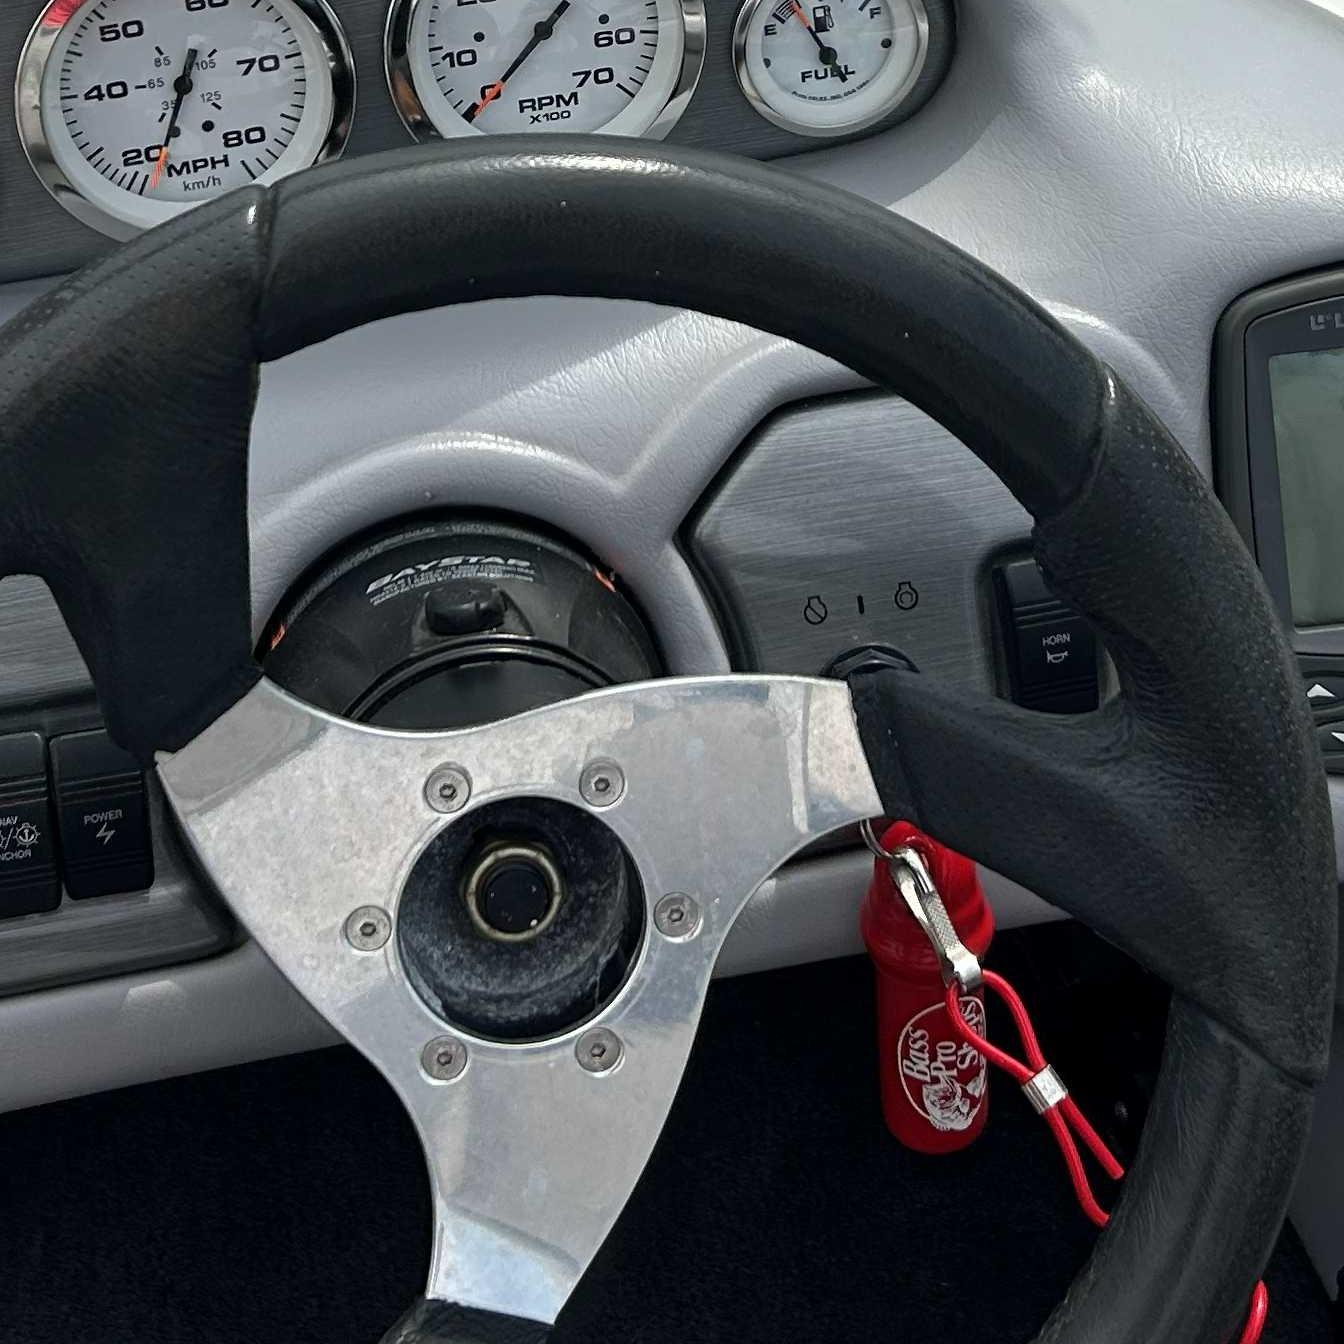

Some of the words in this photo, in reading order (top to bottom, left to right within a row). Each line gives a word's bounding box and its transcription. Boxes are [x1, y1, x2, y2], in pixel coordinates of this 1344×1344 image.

[869, 6, 882, 20] F
[98, 19, 145, 43] 50
[593, 27, 636, 48] 60
[763, 23, 778, 36] E
[195, 59, 217, 71] 105
[236, 54, 280, 77] 70
[441, 49, 478, 68] 10
[572, 67, 615, 88] 70
[83, 80, 129, 102] 40
[199, 90, 222, 103] 125
[518, 92, 580, 114] RPM
[222, 126, 267, 148] 80
[121, 144, 165, 168] 20
[166, 154, 231, 178] MPH
[183, 176, 222, 192] km/h
[1042, 632, 1071, 647] HORN
[83, 809, 123, 825] POWER
[902, 1026, 932, 1083] Bass
[929, 1041, 958, 1077] Pro
